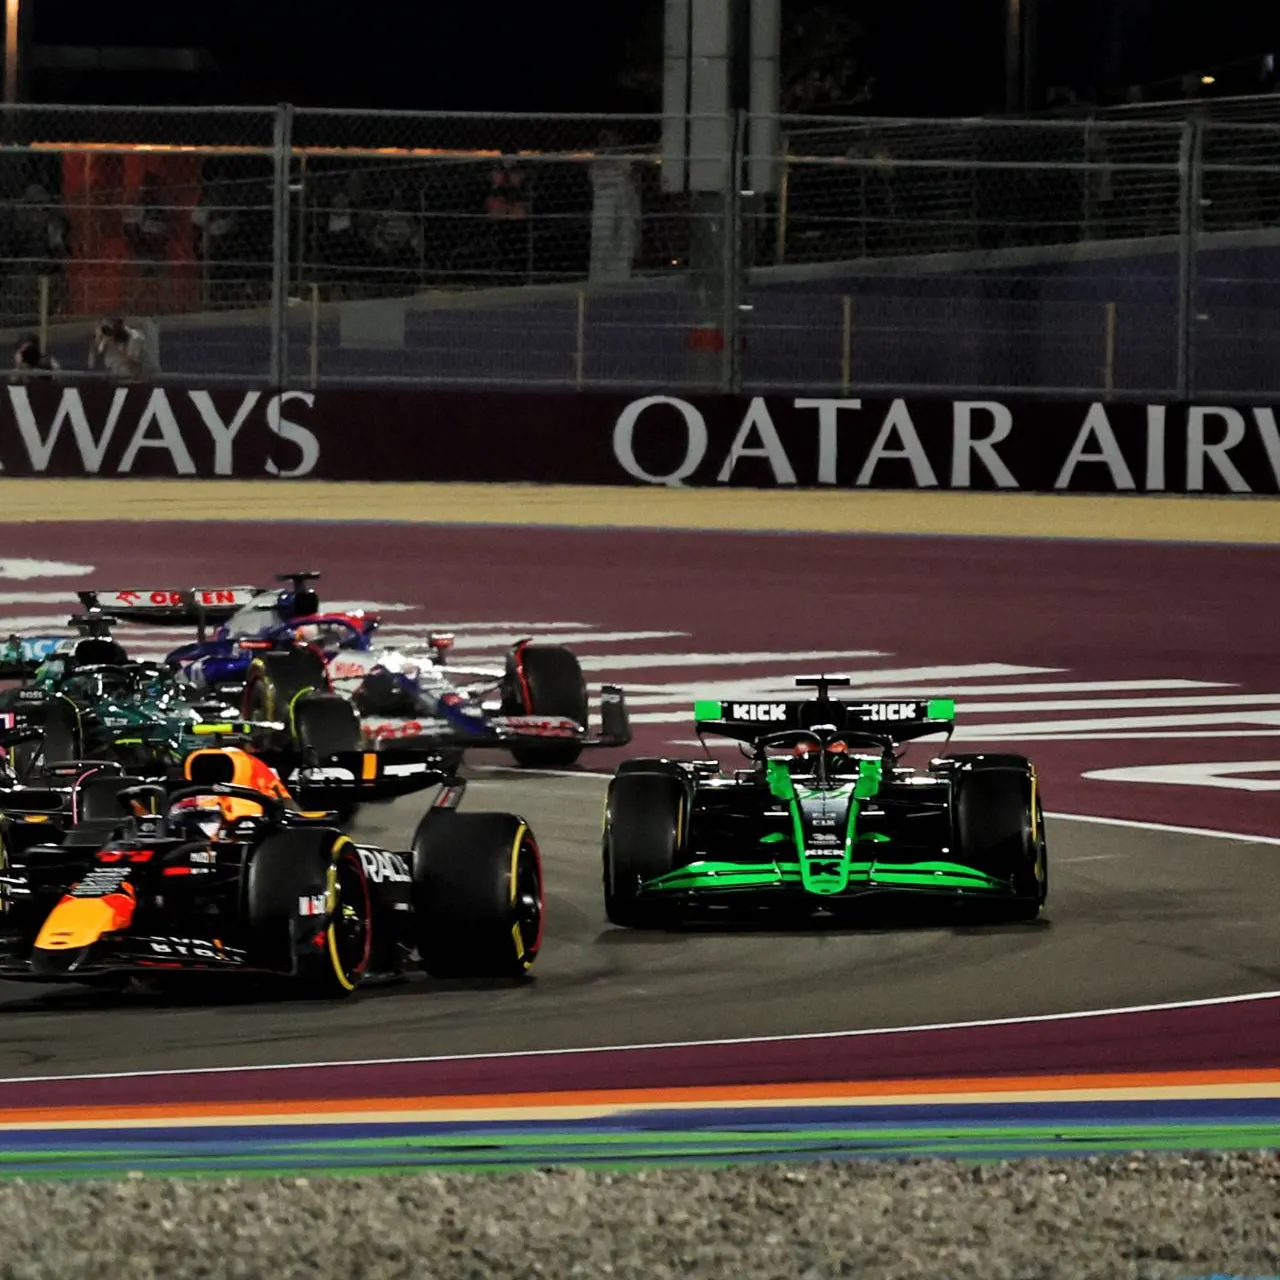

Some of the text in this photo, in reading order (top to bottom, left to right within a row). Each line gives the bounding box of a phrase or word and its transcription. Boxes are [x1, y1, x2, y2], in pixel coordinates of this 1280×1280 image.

[612, 394, 1280, 493] QATAR AIR
[150, 591, 235, 604] OREN
[733, 704, 786, 720] KICK
